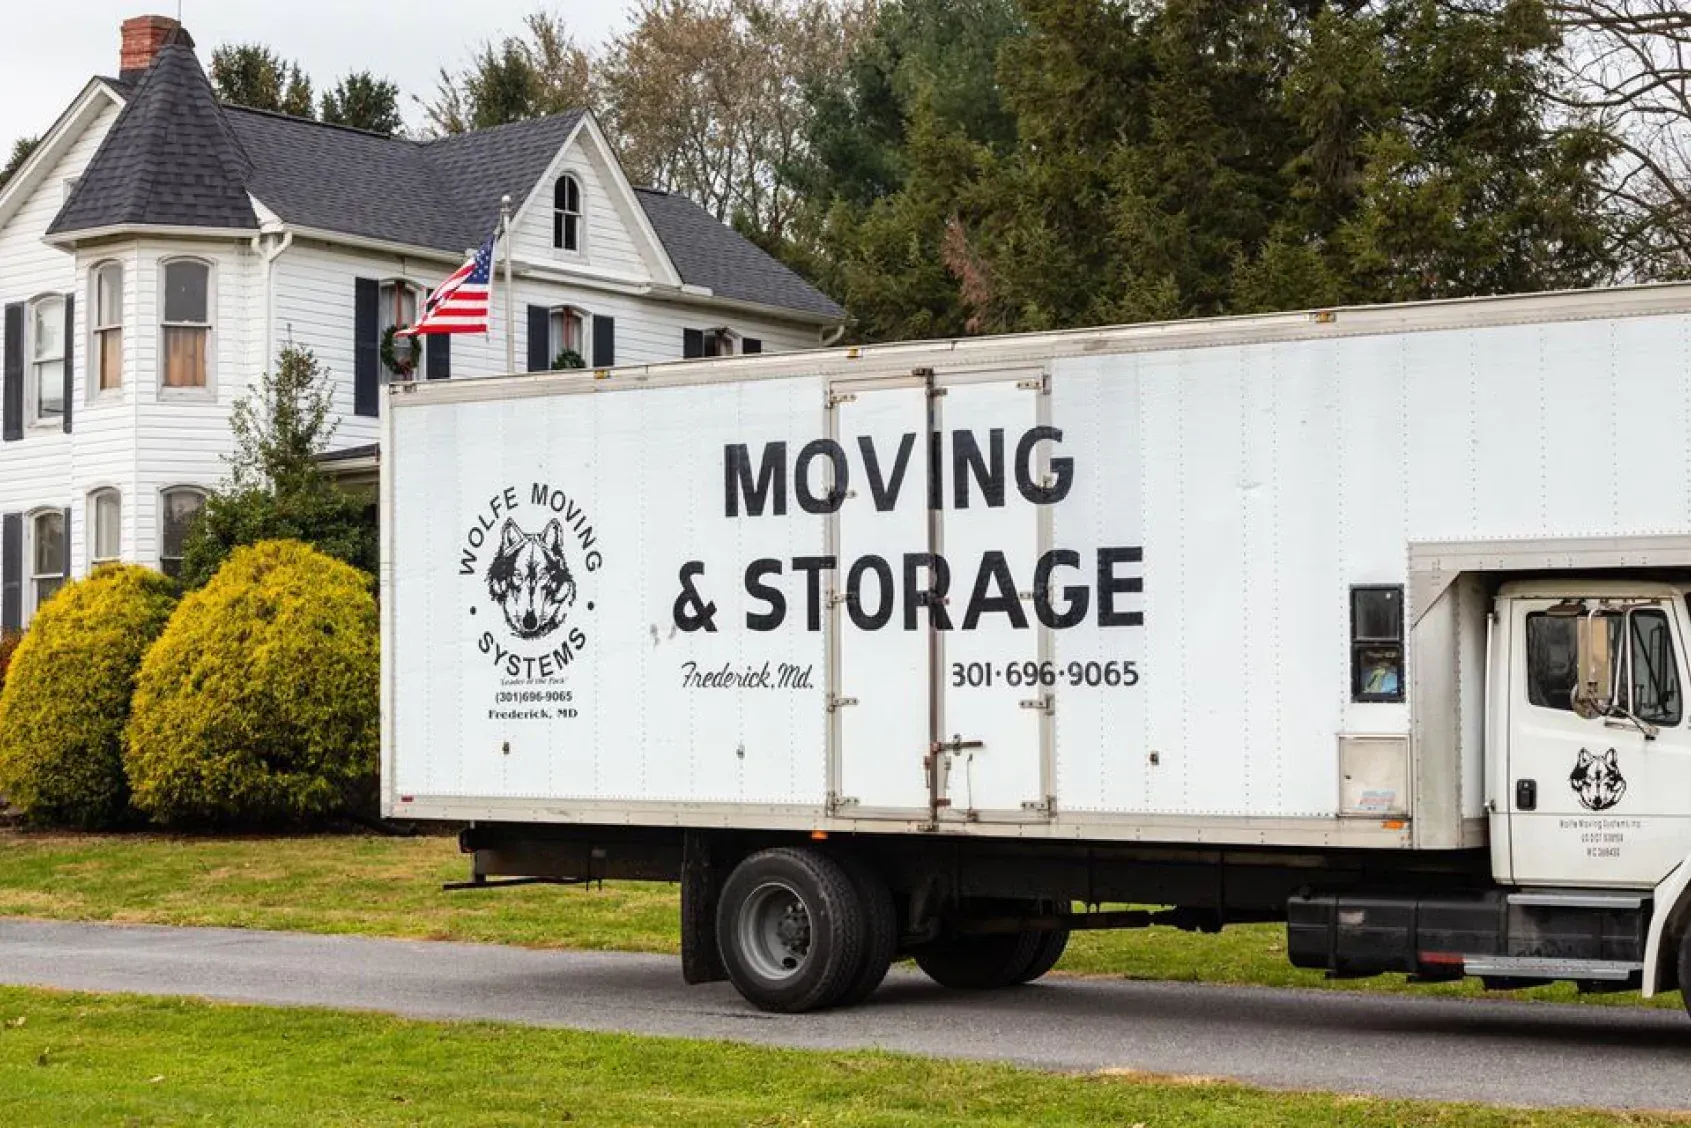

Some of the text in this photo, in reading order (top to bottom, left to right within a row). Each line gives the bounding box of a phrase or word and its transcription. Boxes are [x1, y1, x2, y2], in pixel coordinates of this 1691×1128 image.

[723, 425, 1074, 518] MOVING
[459, 482, 603, 576] WOLFE MOVING
[673, 546, 1144, 633] & STORAGE
[478, 627, 586, 679] SYSTEMS
[495, 690, 573, 704] (301)696-9065
[557, 708, 579, 718] MD
